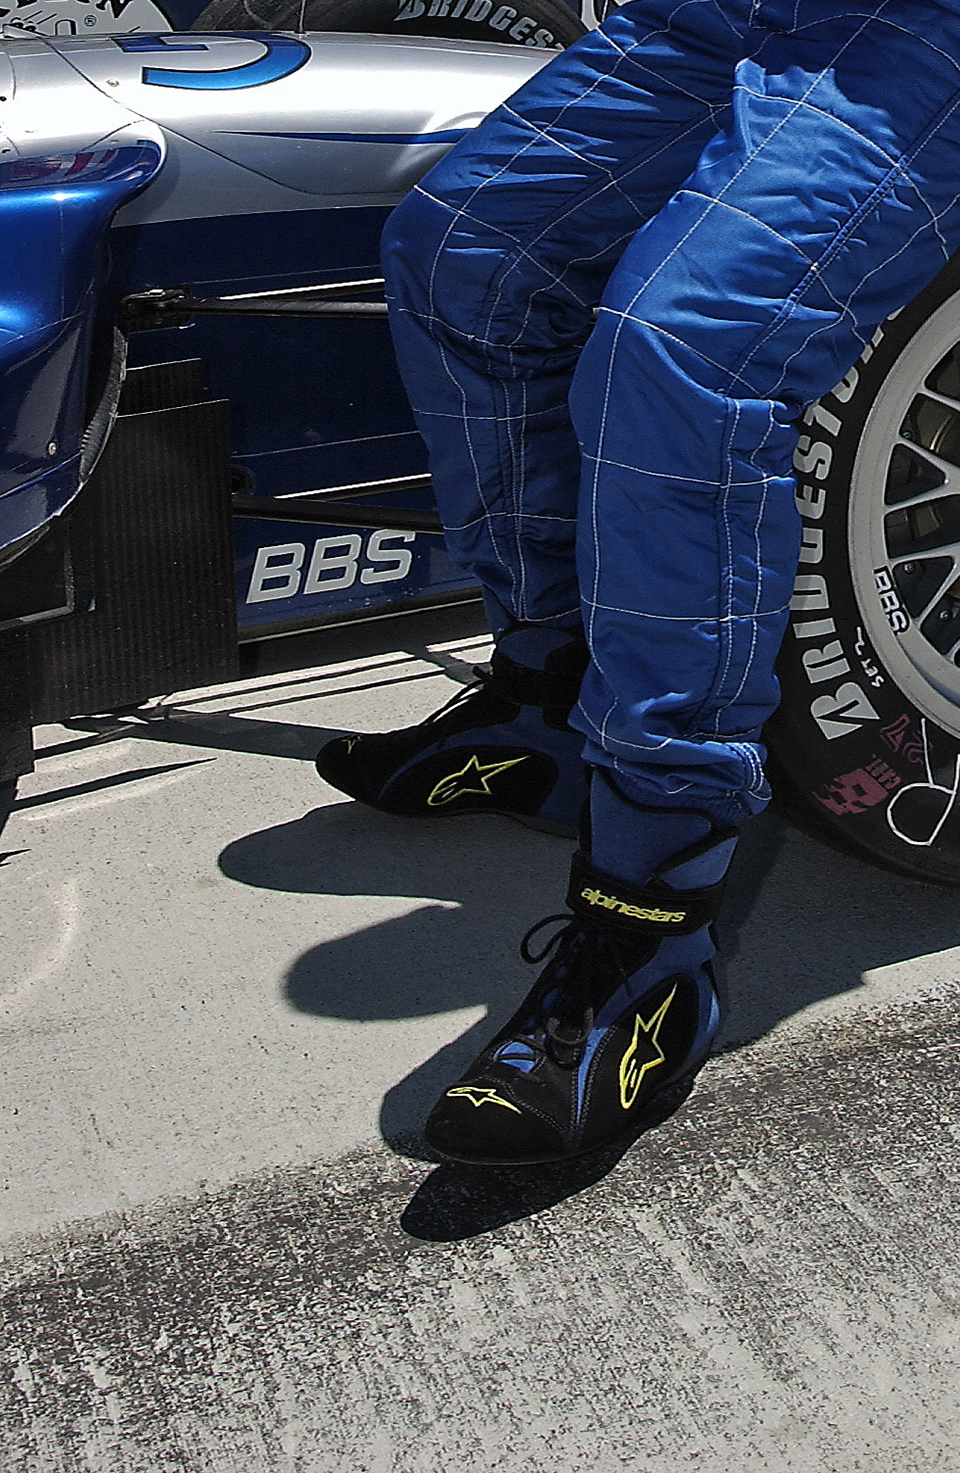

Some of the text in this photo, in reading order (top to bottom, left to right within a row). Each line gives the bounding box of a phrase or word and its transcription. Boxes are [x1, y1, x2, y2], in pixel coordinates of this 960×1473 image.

[245, 528, 416, 605] BBS
[874, 568, 908, 632] BBS
[580, 887, 687, 923] alpinestars
